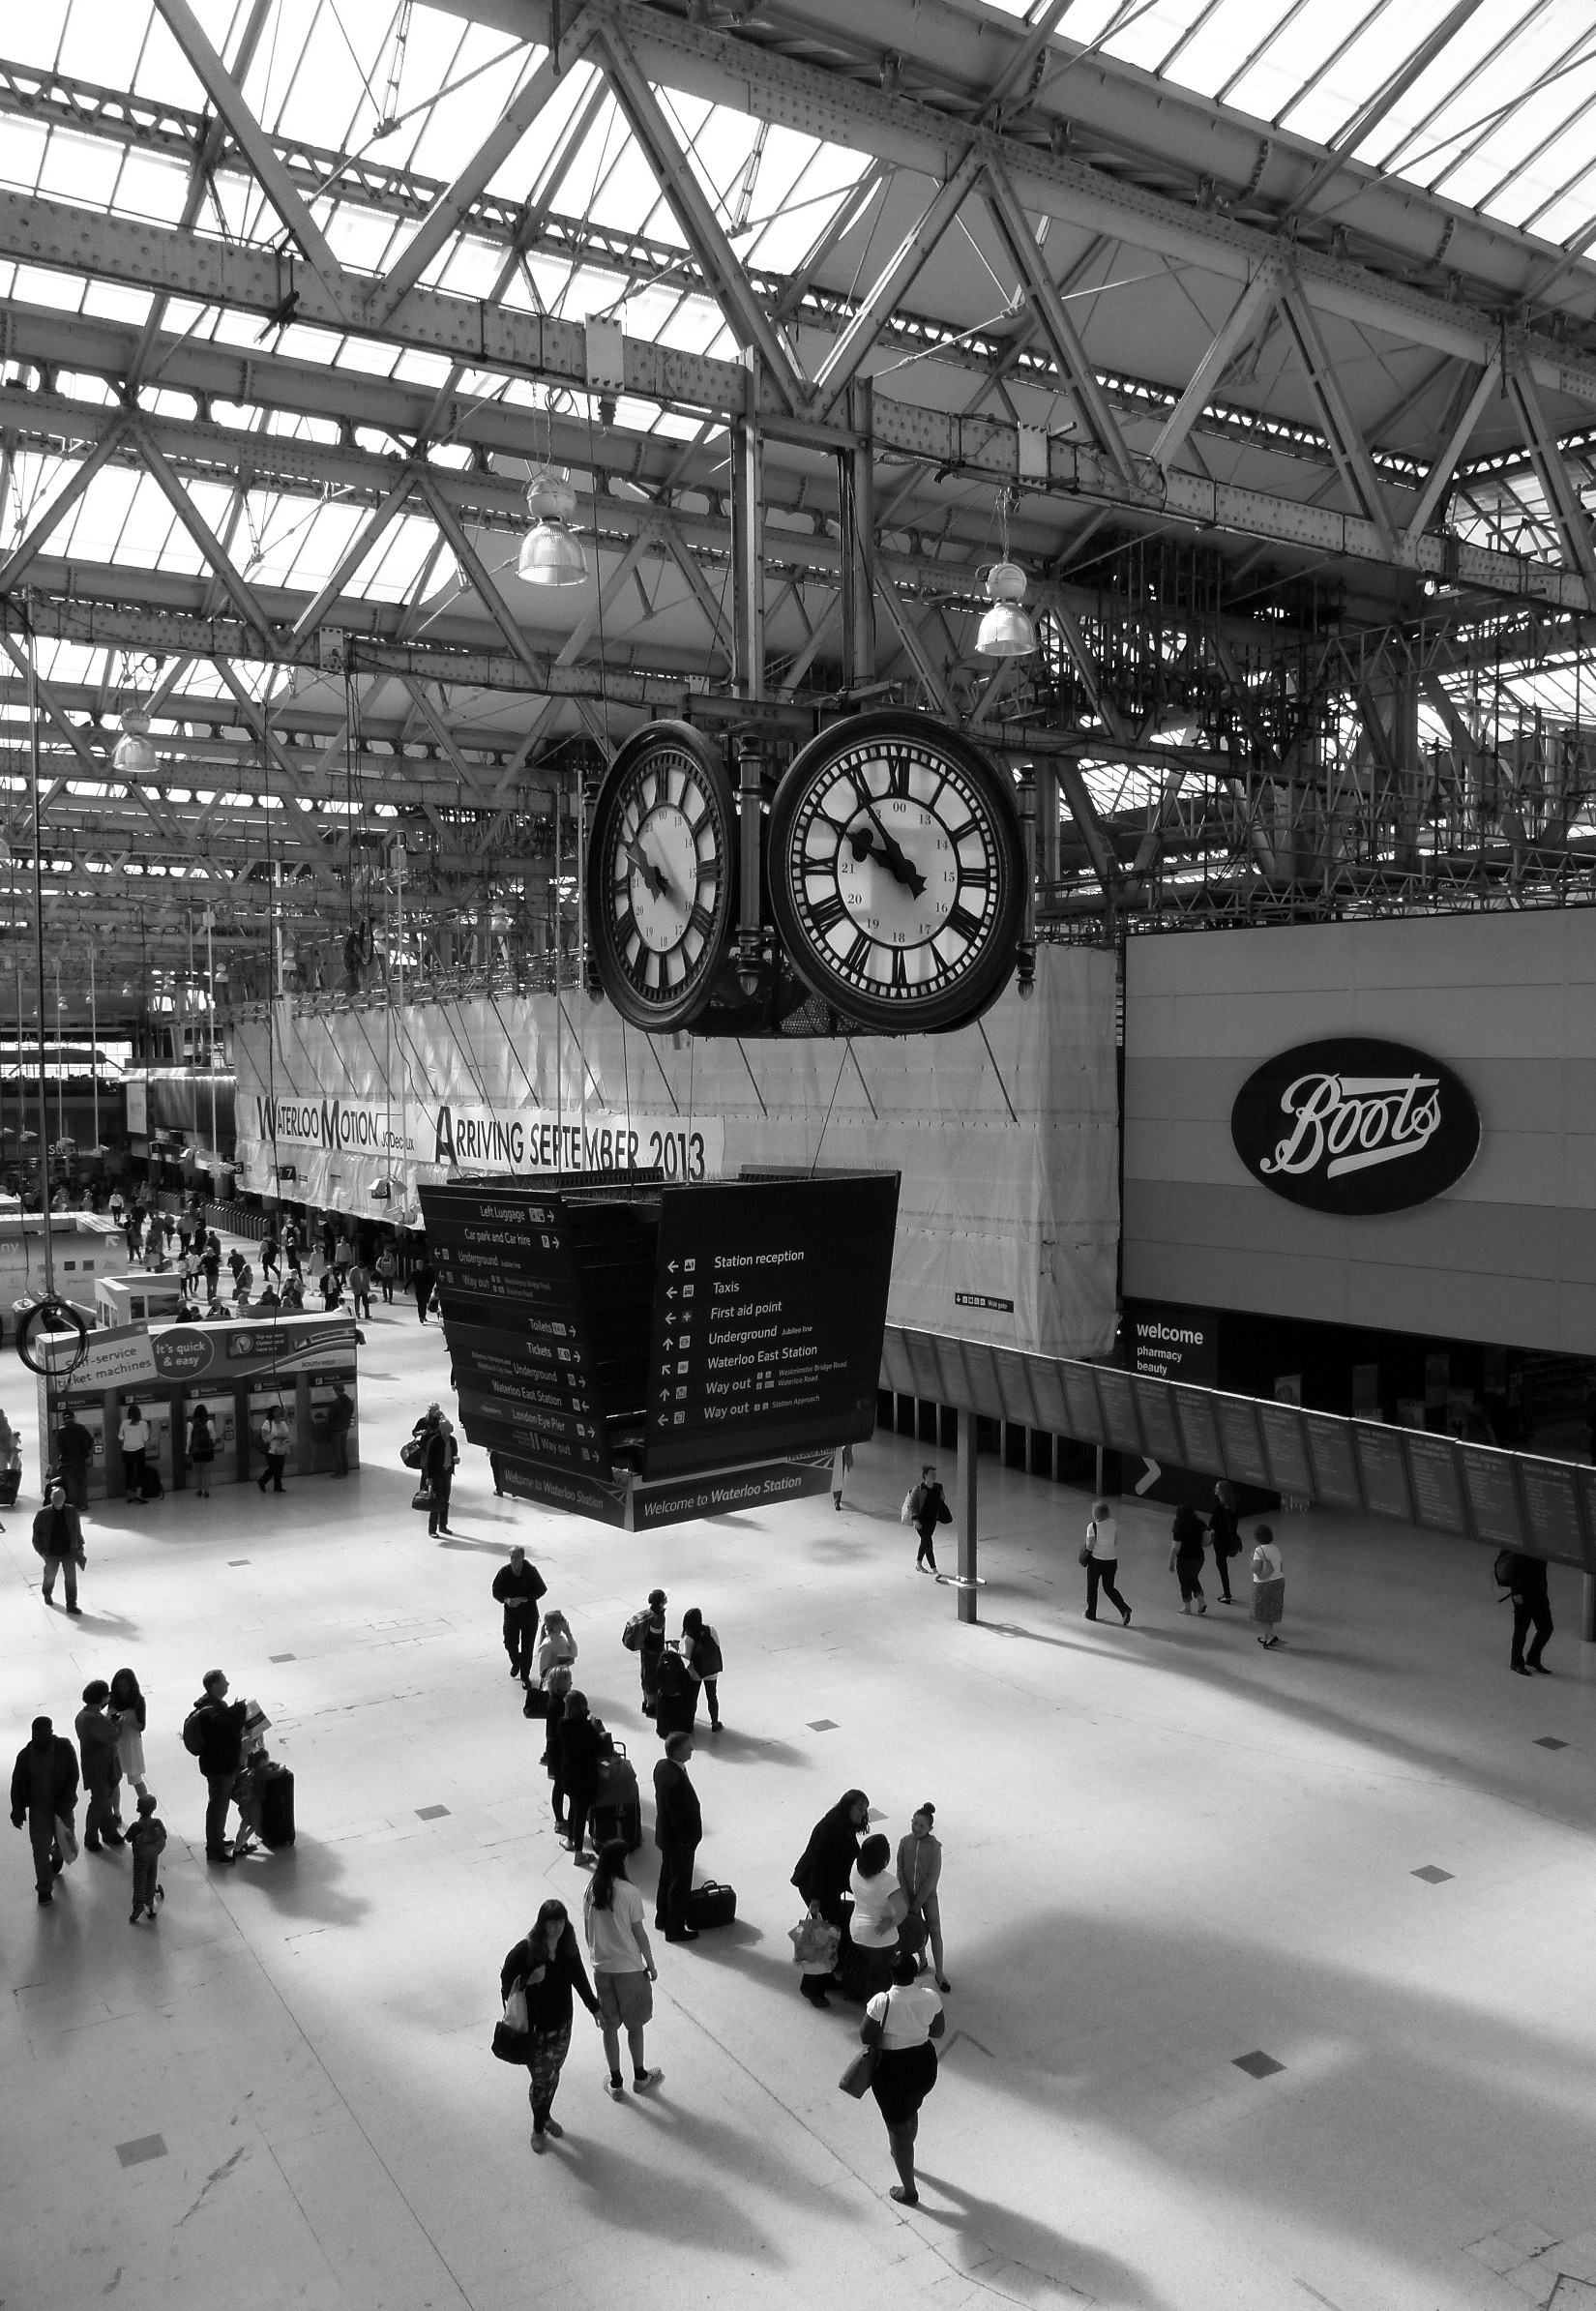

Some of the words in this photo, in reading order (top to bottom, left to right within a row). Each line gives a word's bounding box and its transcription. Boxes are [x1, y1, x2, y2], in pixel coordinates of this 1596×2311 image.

[869, 809, 882, 820] 3
[892, 802, 906, 814] 00
[674, 816, 682, 827] 13
[919, 814, 931, 825] 13
[685, 838, 693, 848] 14
[935, 840, 949, 851] 14
[842, 863, 855, 874] 21
[942, 872, 955, 882] 15
[847, 894, 862, 904] 20
[935, 903, 948, 913] 16
[867, 918, 880, 929] 19
[919, 924, 931, 935] 17
[660, 936, 667, 947] 18
[892, 932, 905, 943] 18
[321, 1099, 379, 1150] MOTION
[1260, 1073, 1441, 1179] Boots
[436, 1106, 524, 1166] ARRIVING
[649, 1130, 705, 1182] 2013
[480, 1205, 495, 1218] Left
[495, 1206, 525, 1223] Luggage
[464, 1228, 476, 1240] Car
[476, 1230, 490, 1243] park
[491, 1231, 504, 1244] and
[504, 1231, 517, 1245] Car
[517, 1233, 531, 1246] hire
[714, 1256, 753, 1268] Station
[755, 1250, 805, 1266] reception
[713, 1281, 740, 1294] Taxis
[710, 1306, 734, 1319] First
[736, 1303, 753, 1317] aid
[754, 1301, 783, 1317] point
[528, 1318, 552, 1334] Toilets
[1137, 1321, 1204, 1346] welcome
[708, 1325, 778, 1345] Underground
[157, 1344, 174, 1354] It's
[176, 1341, 206, 1355] quick
[526, 1342, 552, 1358] Tickets
[1137, 1345, 1182, 1363] pharmacy
[176, 1356, 199, 1367] easy
[707, 1354, 754, 1370] Waterloo
[757, 1349, 780, 1363] East
[782, 1345, 817, 1360] Station
[833, 1360, 847, 1369] Road
[57, 1372, 94, 1388] tiket
[96, 1358, 152, 1379] machines
[513, 1362, 557, 1382] Underground
[1137, 1360, 1167, 1376] beauty
[491, 1380, 520, 1397] Waterloo
[521, 1386, 536, 1401] East
[536, 1390, 562, 1407] Station
[705, 1381, 729, 1395] Way
[732, 1378, 752, 1391] out
[703, 1406, 727, 1419] Way
[730, 1403, 750, 1415] out
[511, 1407, 537, 1424] London
[538, 1414, 550, 1429] Eye
[550, 1417, 565, 1432] Pier
[541, 1437, 557, 1454] Way
[557, 1445, 572, 1456] out
[505, 1469, 533, 1489] Welcome
[535, 1478, 542, 1491] to
[543, 1481, 576, 1500] Waterloo
[576, 1491, 604, 1509] Station
[644, 1497, 695, 1517] Welcome
[696, 1494, 708, 1506] to
[711, 1484, 761, 1503] Waterloo
[763, 1475, 802, 1493] Station
